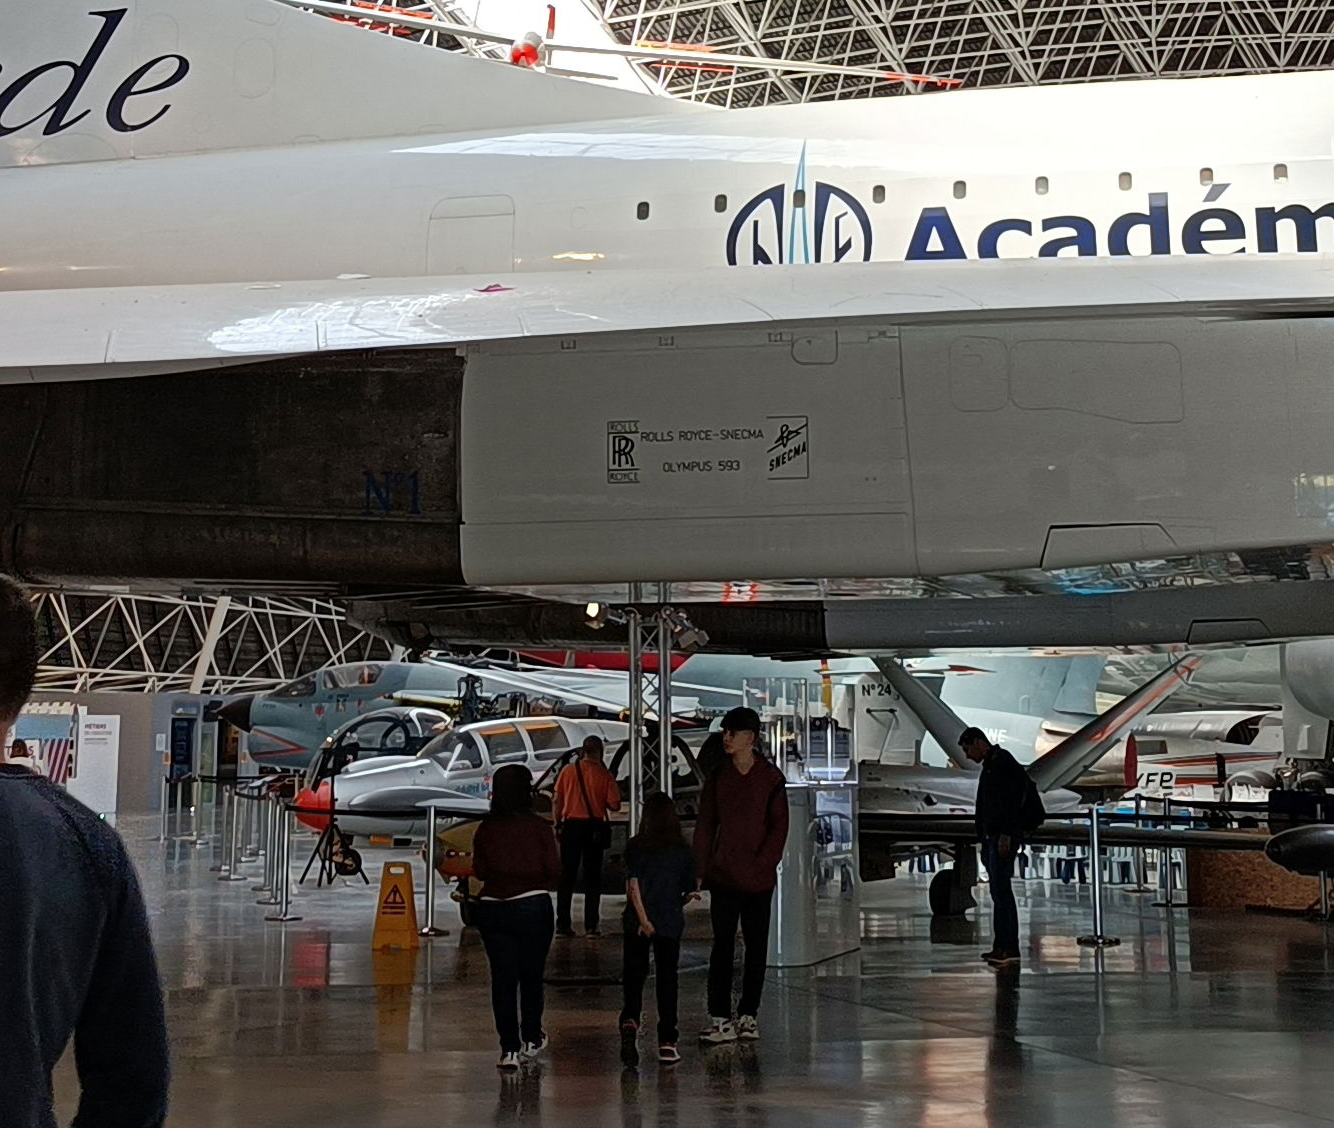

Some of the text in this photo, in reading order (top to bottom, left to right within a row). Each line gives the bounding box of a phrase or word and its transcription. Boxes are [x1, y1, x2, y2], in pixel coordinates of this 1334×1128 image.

[640, 429, 765, 442] ROLLS ROYCE-SNECMA
[769, 441, 807, 472] SNECMA
[662, 460, 741, 473] OLYMPUS 593
[609, 472, 639, 481] ROYCE
